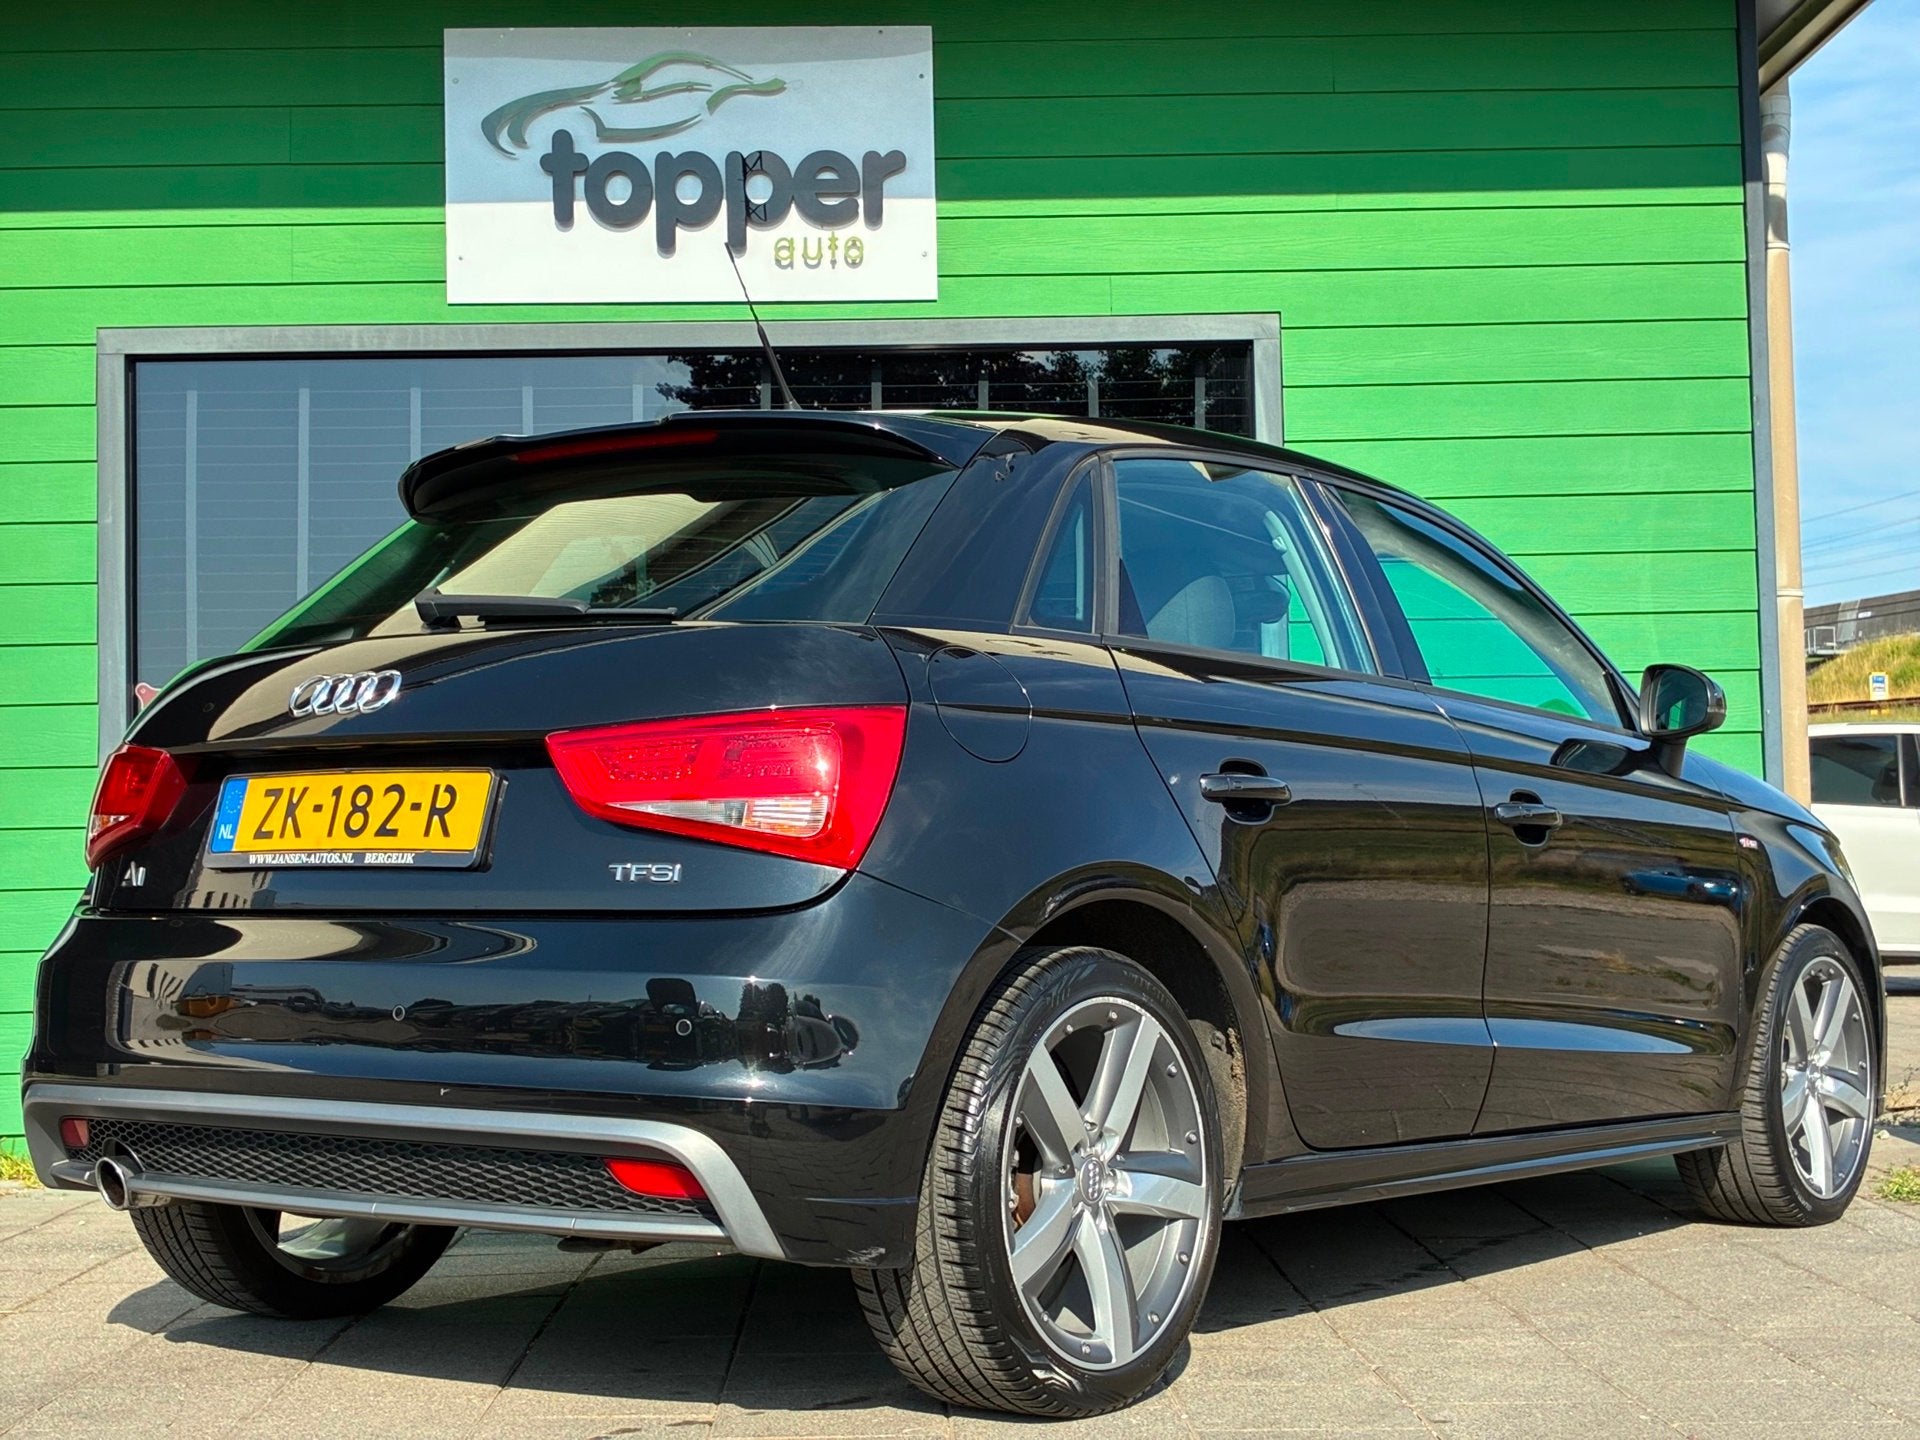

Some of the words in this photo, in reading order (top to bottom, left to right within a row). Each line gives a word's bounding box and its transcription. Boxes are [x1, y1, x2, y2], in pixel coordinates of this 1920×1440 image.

[540, 129, 906, 257] topper
[774, 231, 864, 269] auto
[252, 783, 458, 840] ZK-182-R
[218, 823, 234, 839] NL
[608, 863, 682, 882] TFSI
